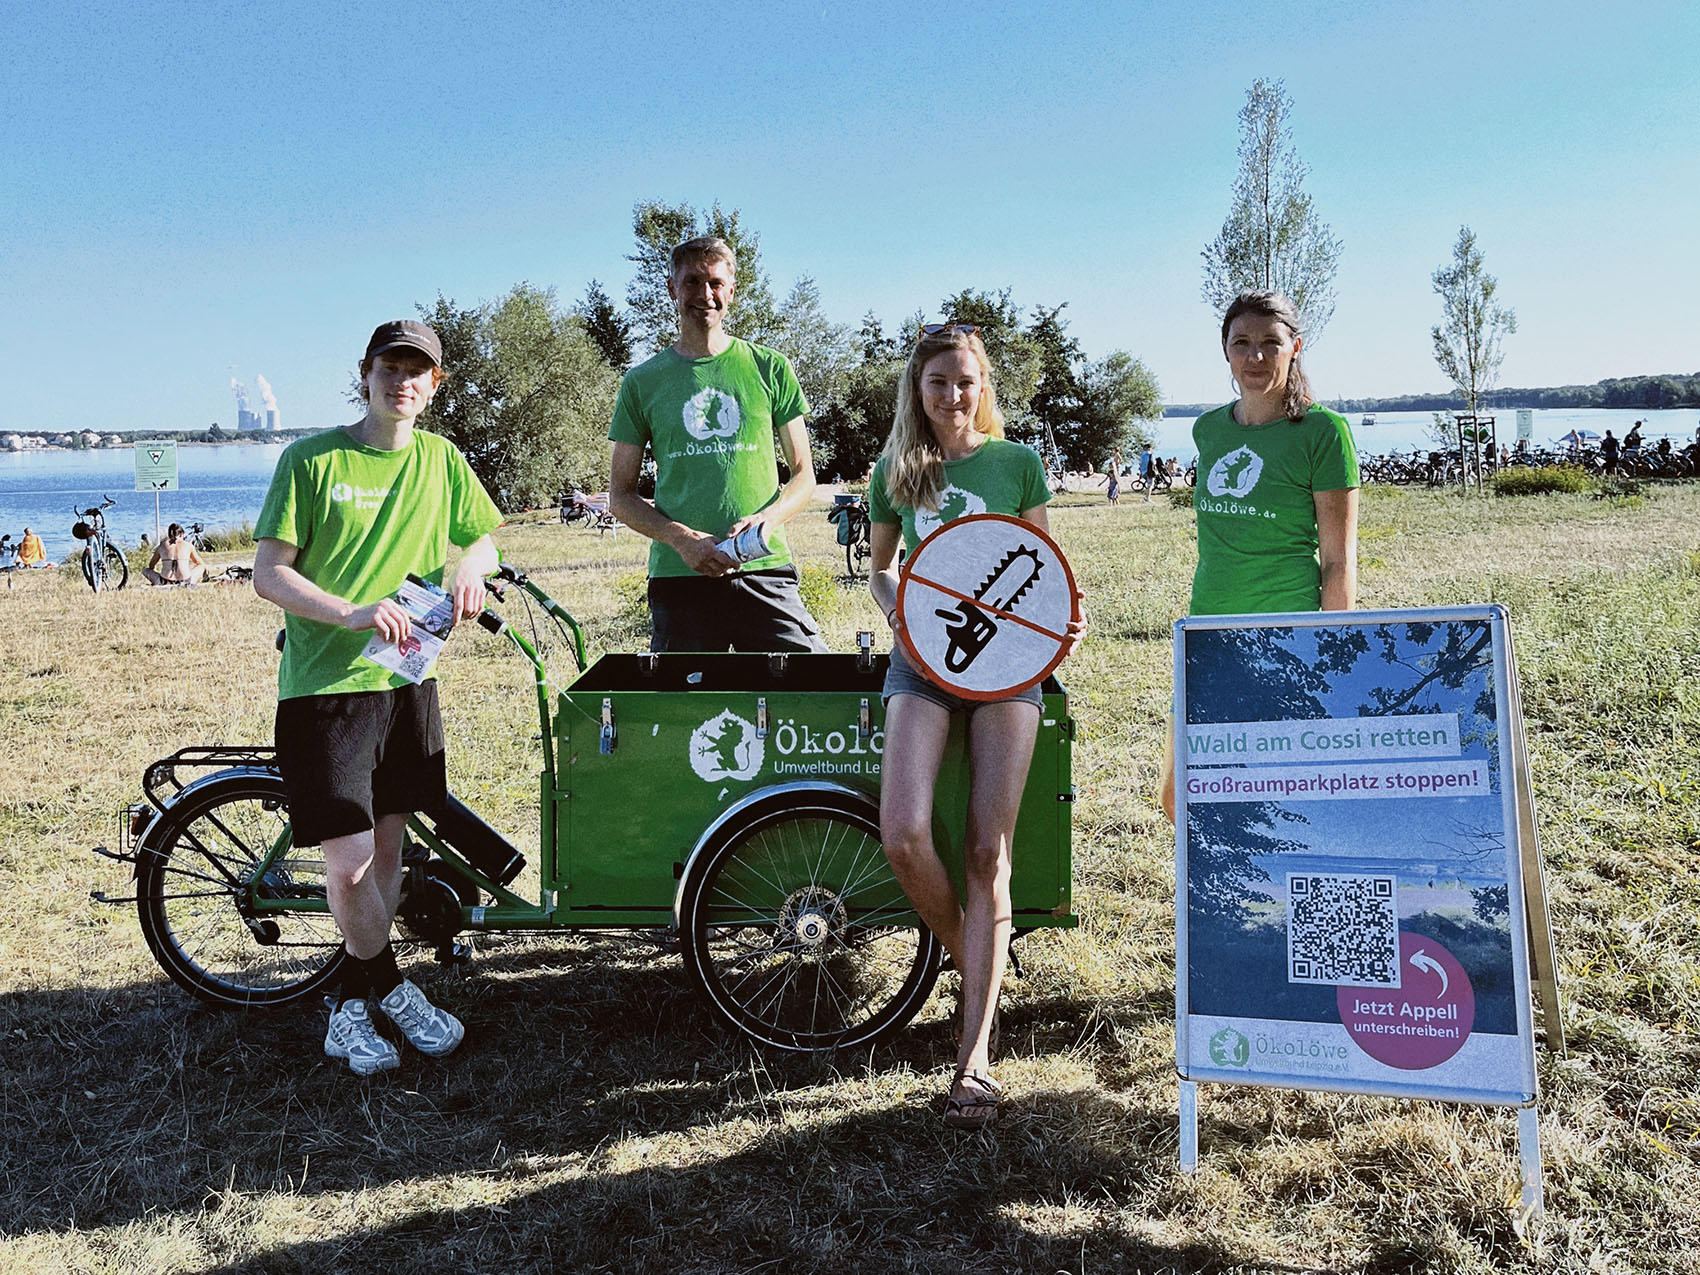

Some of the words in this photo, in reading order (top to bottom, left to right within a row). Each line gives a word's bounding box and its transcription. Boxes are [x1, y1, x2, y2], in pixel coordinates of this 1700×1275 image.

[775, 718, 885, 755] Ökolö
[1187, 732, 1248, 754] Wald
[1256, 735, 1292, 752] am
[1300, 728, 1361, 751] Cossi
[1371, 728, 1448, 748] retten
[774, 760, 861, 774] Umweltbund
[1186, 773, 1379, 796] Großraumparkplatz
[1385, 769, 1479, 792] stoppen!
[1352, 999, 1395, 1016] Jetzt
[1400, 1002, 1457, 1022] Appell
[1353, 1022, 1460, 1039] unterschreiben!
[1256, 1033, 1348, 1059] Ökolöwe
